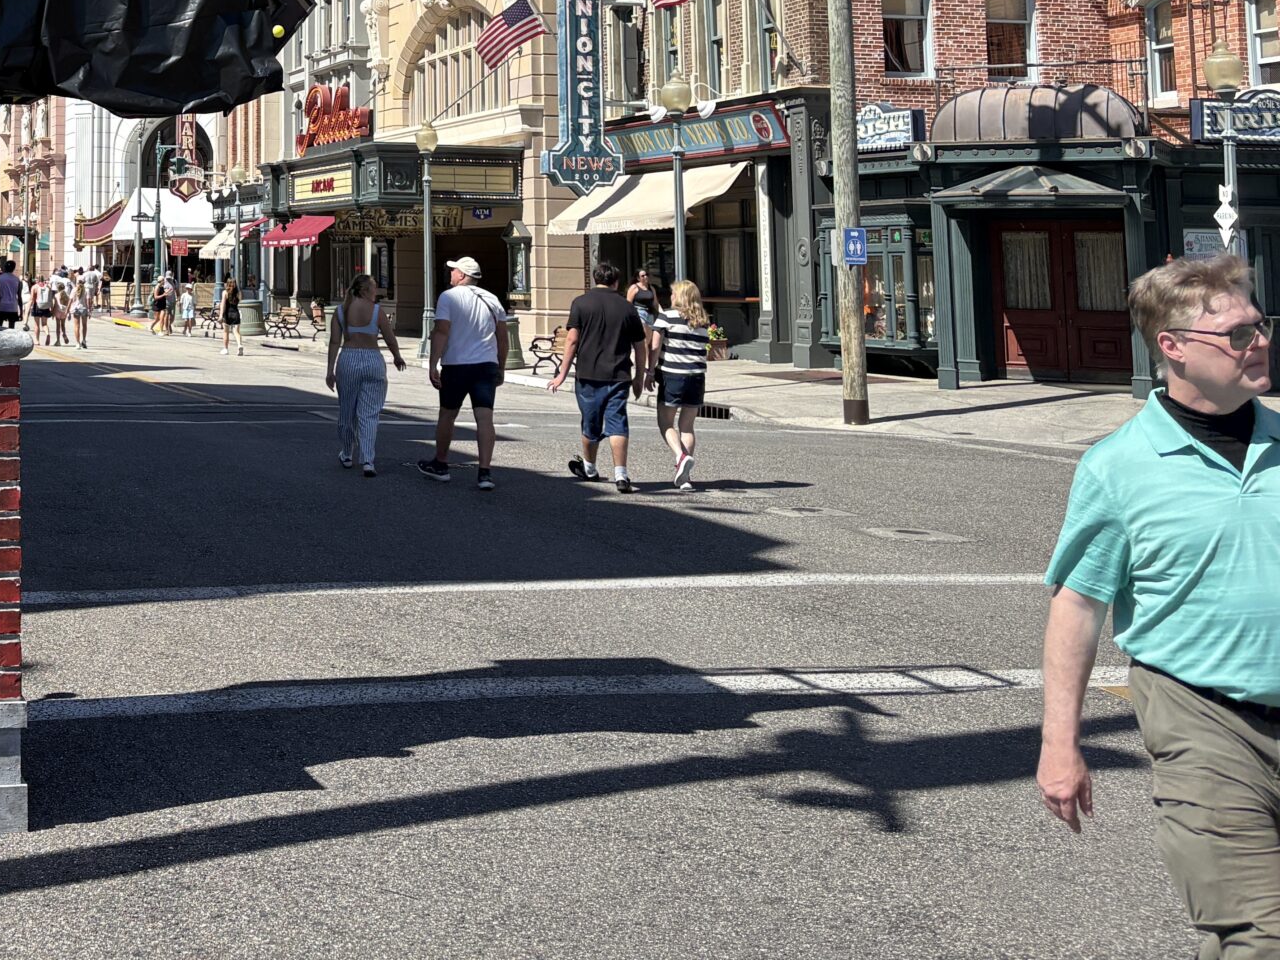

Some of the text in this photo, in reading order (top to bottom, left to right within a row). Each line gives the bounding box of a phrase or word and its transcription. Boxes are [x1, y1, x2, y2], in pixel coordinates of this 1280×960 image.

[684, 120, 728, 146] NEWS
[856, 116, 905, 138] RISH
[562, 155, 614, 173] NEWS
[474, 208, 490, 216] ATM
[431, 215, 460, 228] KILL
